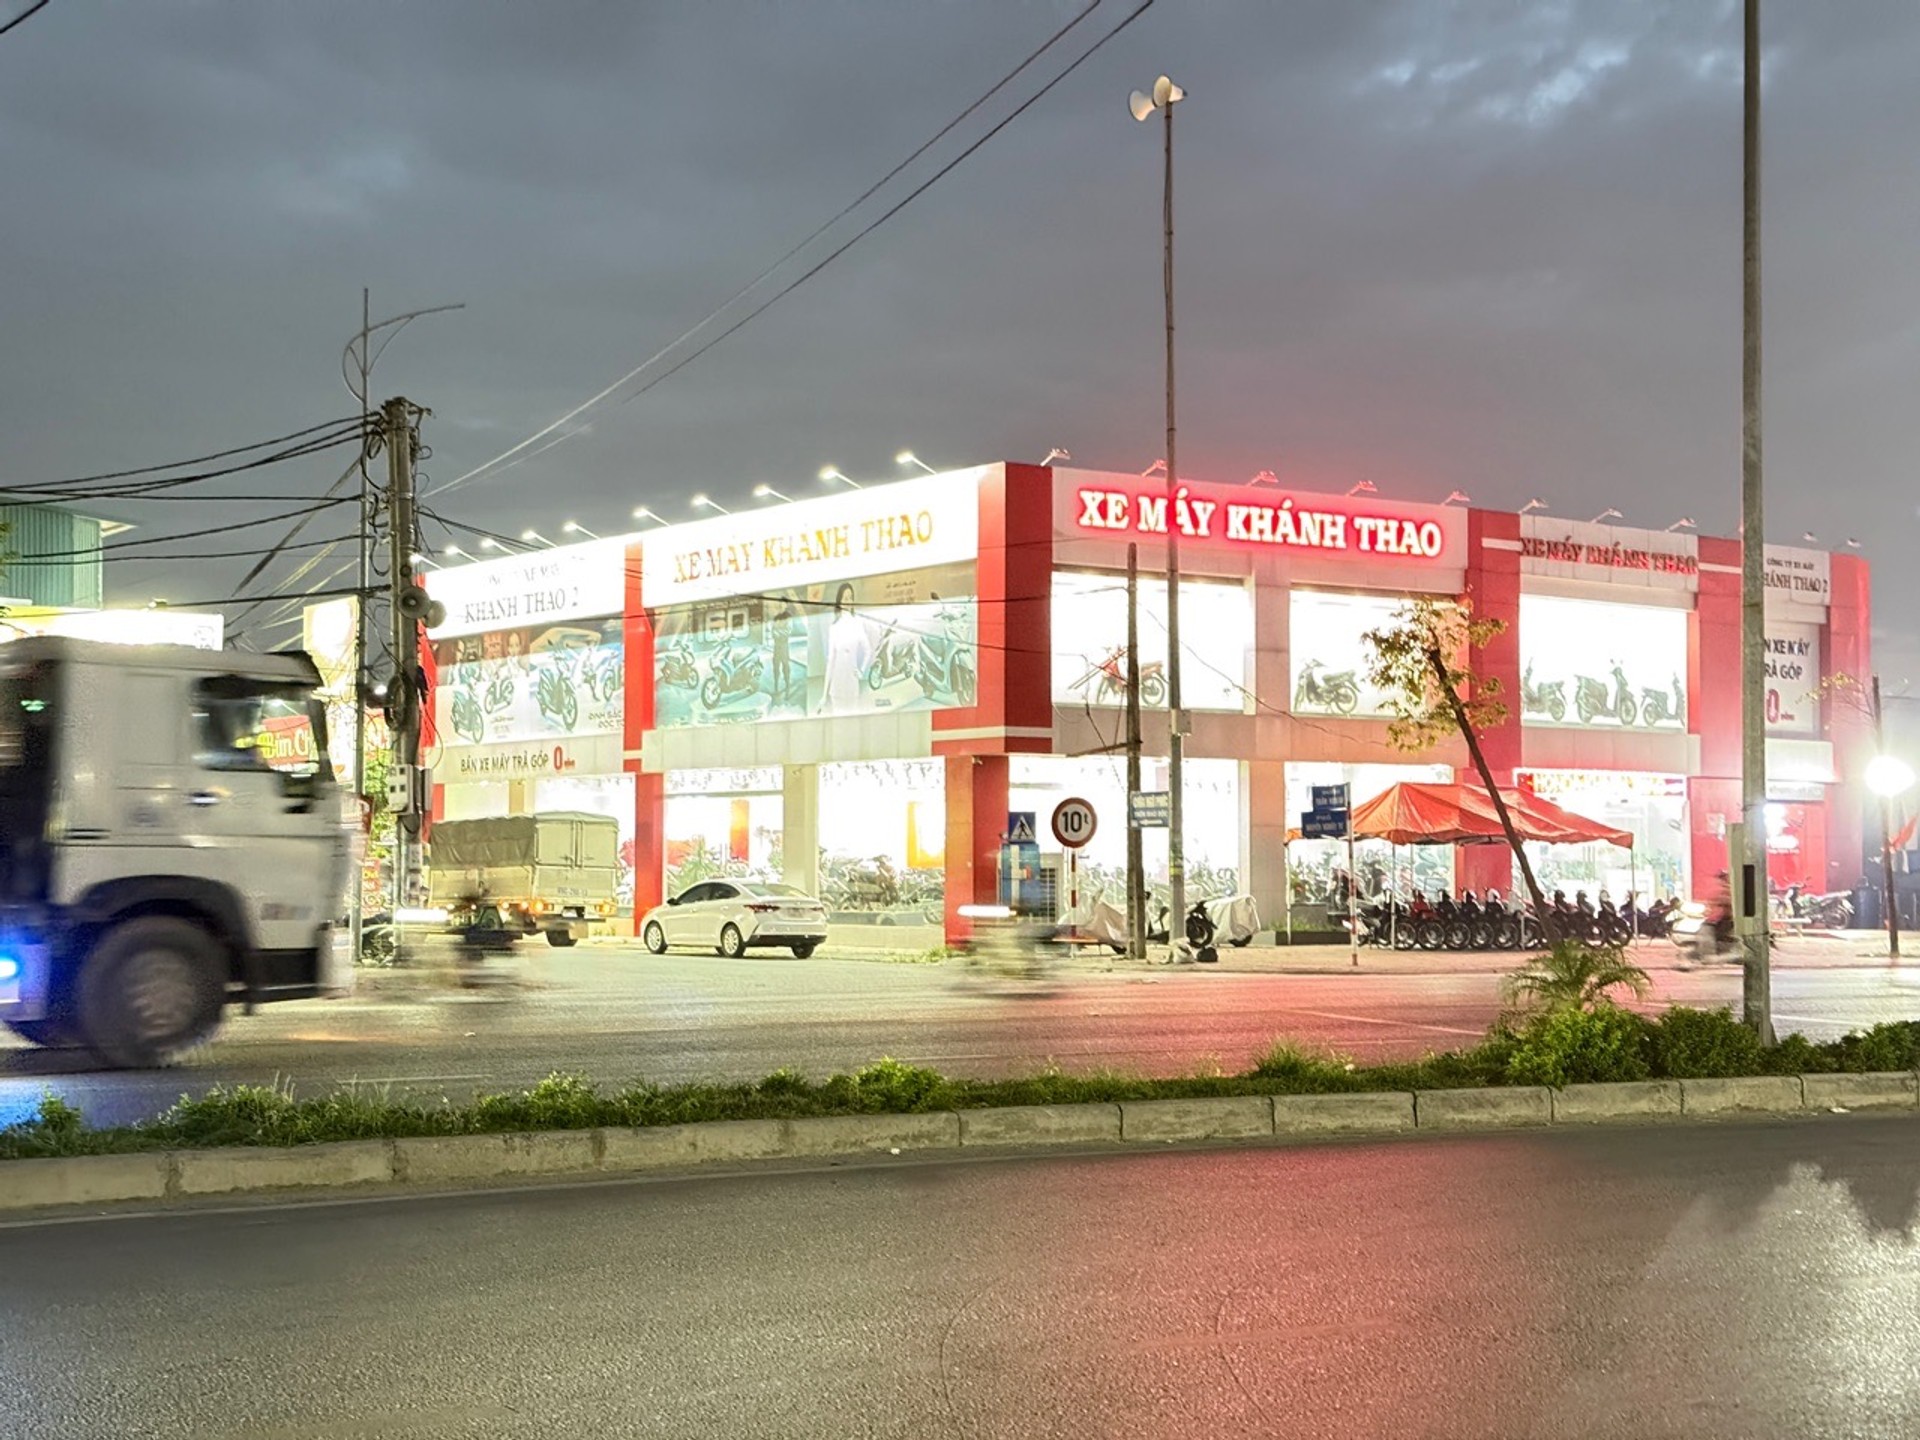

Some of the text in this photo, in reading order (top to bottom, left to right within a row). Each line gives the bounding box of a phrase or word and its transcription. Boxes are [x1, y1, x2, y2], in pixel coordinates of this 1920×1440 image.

[1079, 488, 1442, 557] XE MÁY KHÁNH THAO
[673, 551, 701, 583] XE
[860, 511, 933, 552] THAO
[1519, 537, 1545, 558] XE
[1793, 575, 1821, 593] THAO
[1823, 579, 1828, 593] 2
[1772, 639, 1786, 654] XE
[1780, 661, 1803, 680] GÓP
[460, 756, 477, 773] BÁN
[480, 756, 490, 772] XE
[492, 753, 509, 772] MÁY
[512, 751, 529, 770] TRẢ
[531, 750, 549, 768] GÓP
[553, 745, 563, 770] 0
